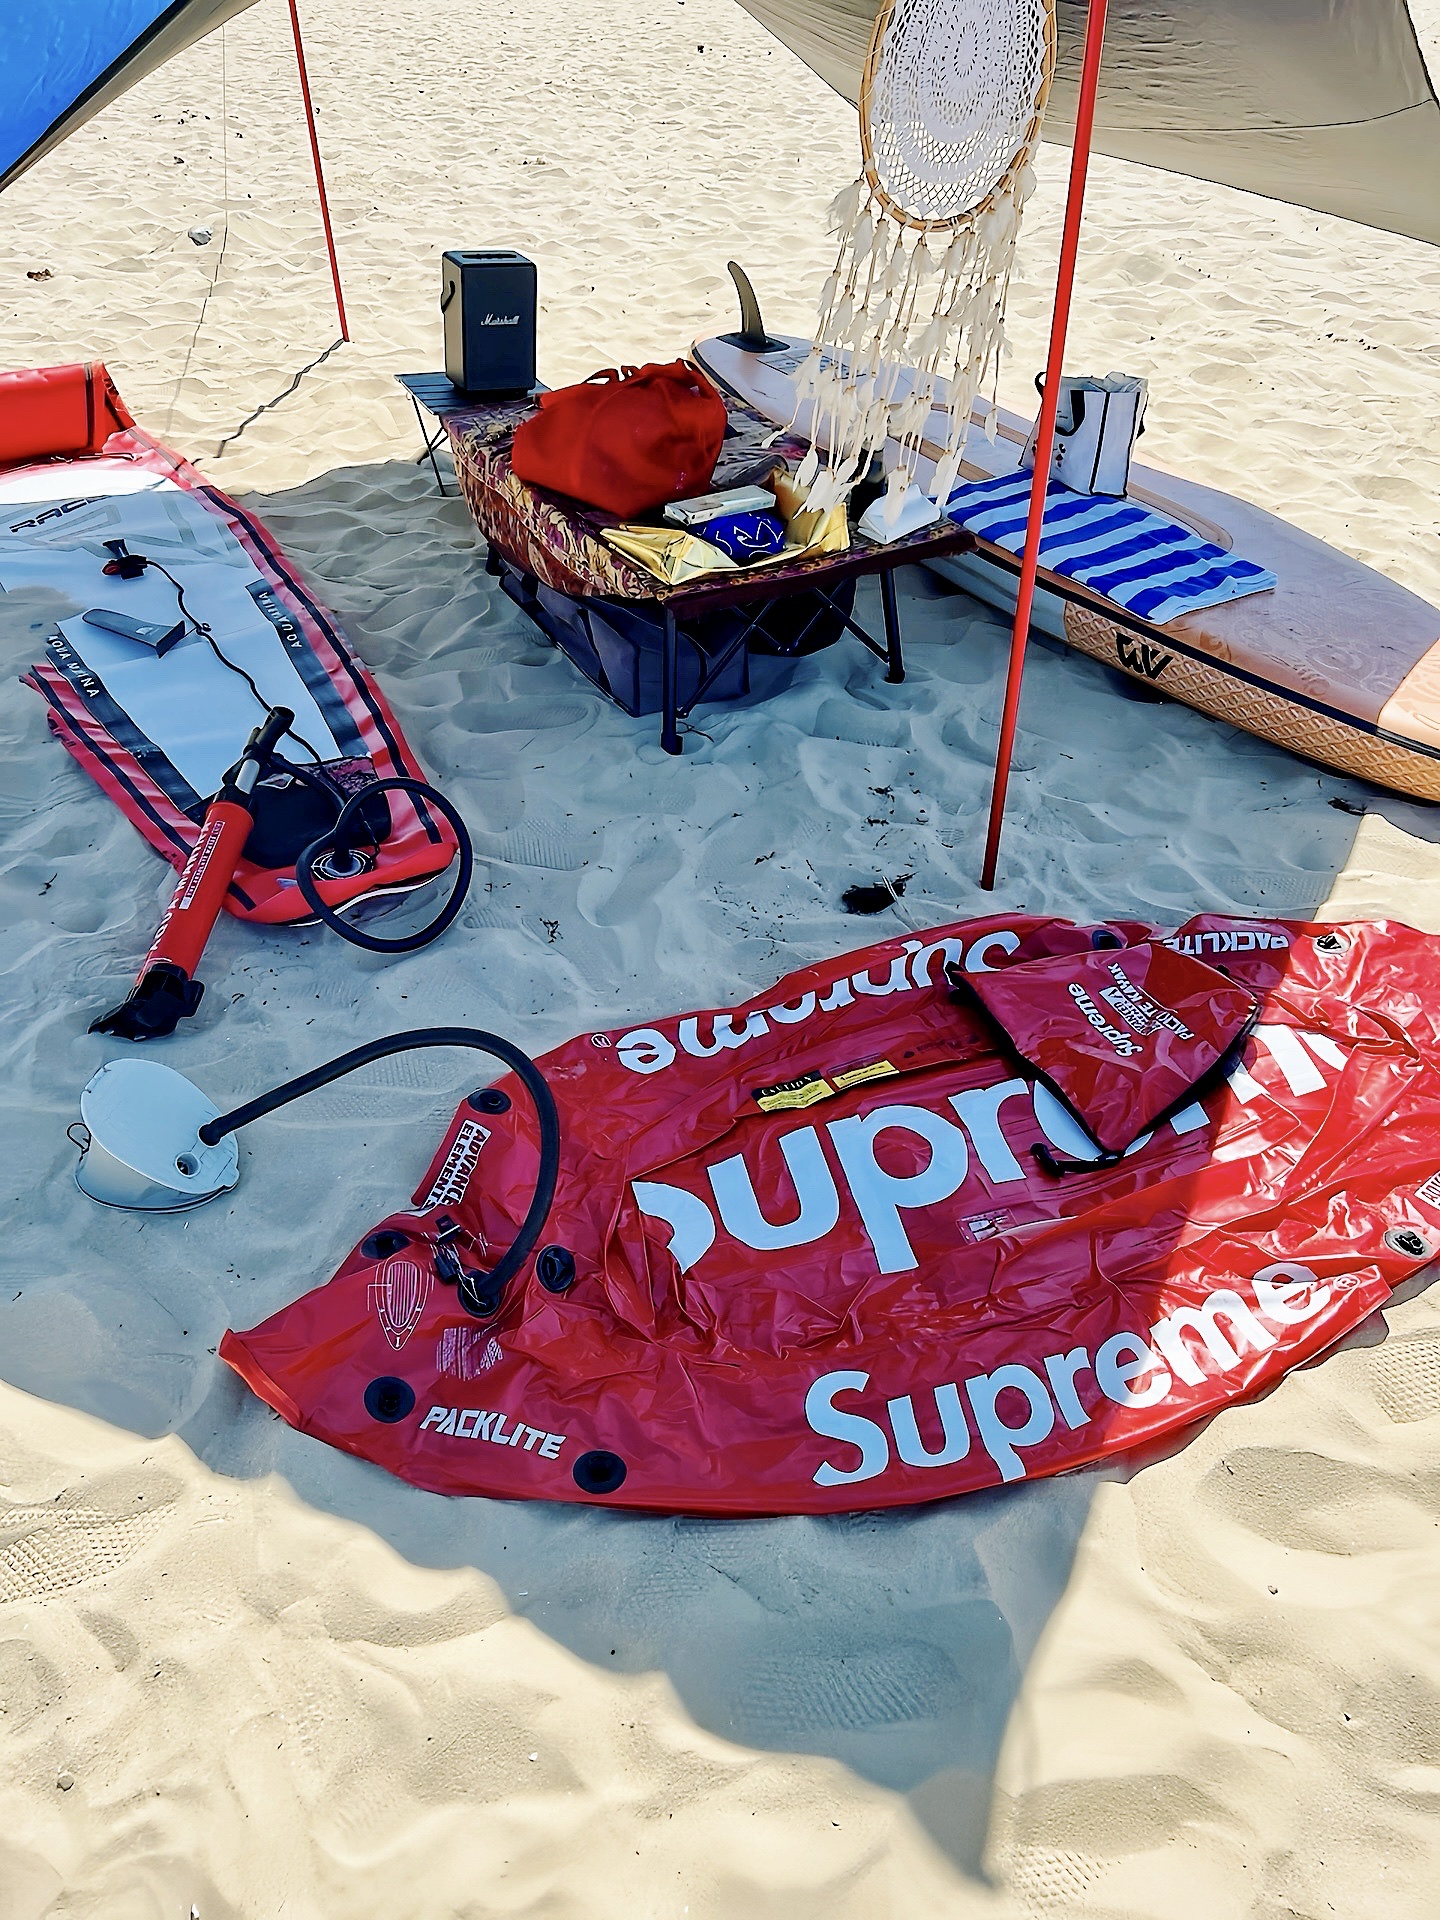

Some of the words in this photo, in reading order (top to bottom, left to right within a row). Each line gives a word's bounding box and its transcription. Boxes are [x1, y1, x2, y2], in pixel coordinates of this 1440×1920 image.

[48, 635, 72, 661] AQUA
[277, 616, 303, 648] AQUA
[1162, 931, 1290, 955] PACKLITE
[1107, 961, 1144, 1003] KAYAK
[1067, 982, 1144, 1057] Supreme
[804, 1262, 1331, 1486] Supreme
[419, 1405, 567, 1460] PACKLITE
